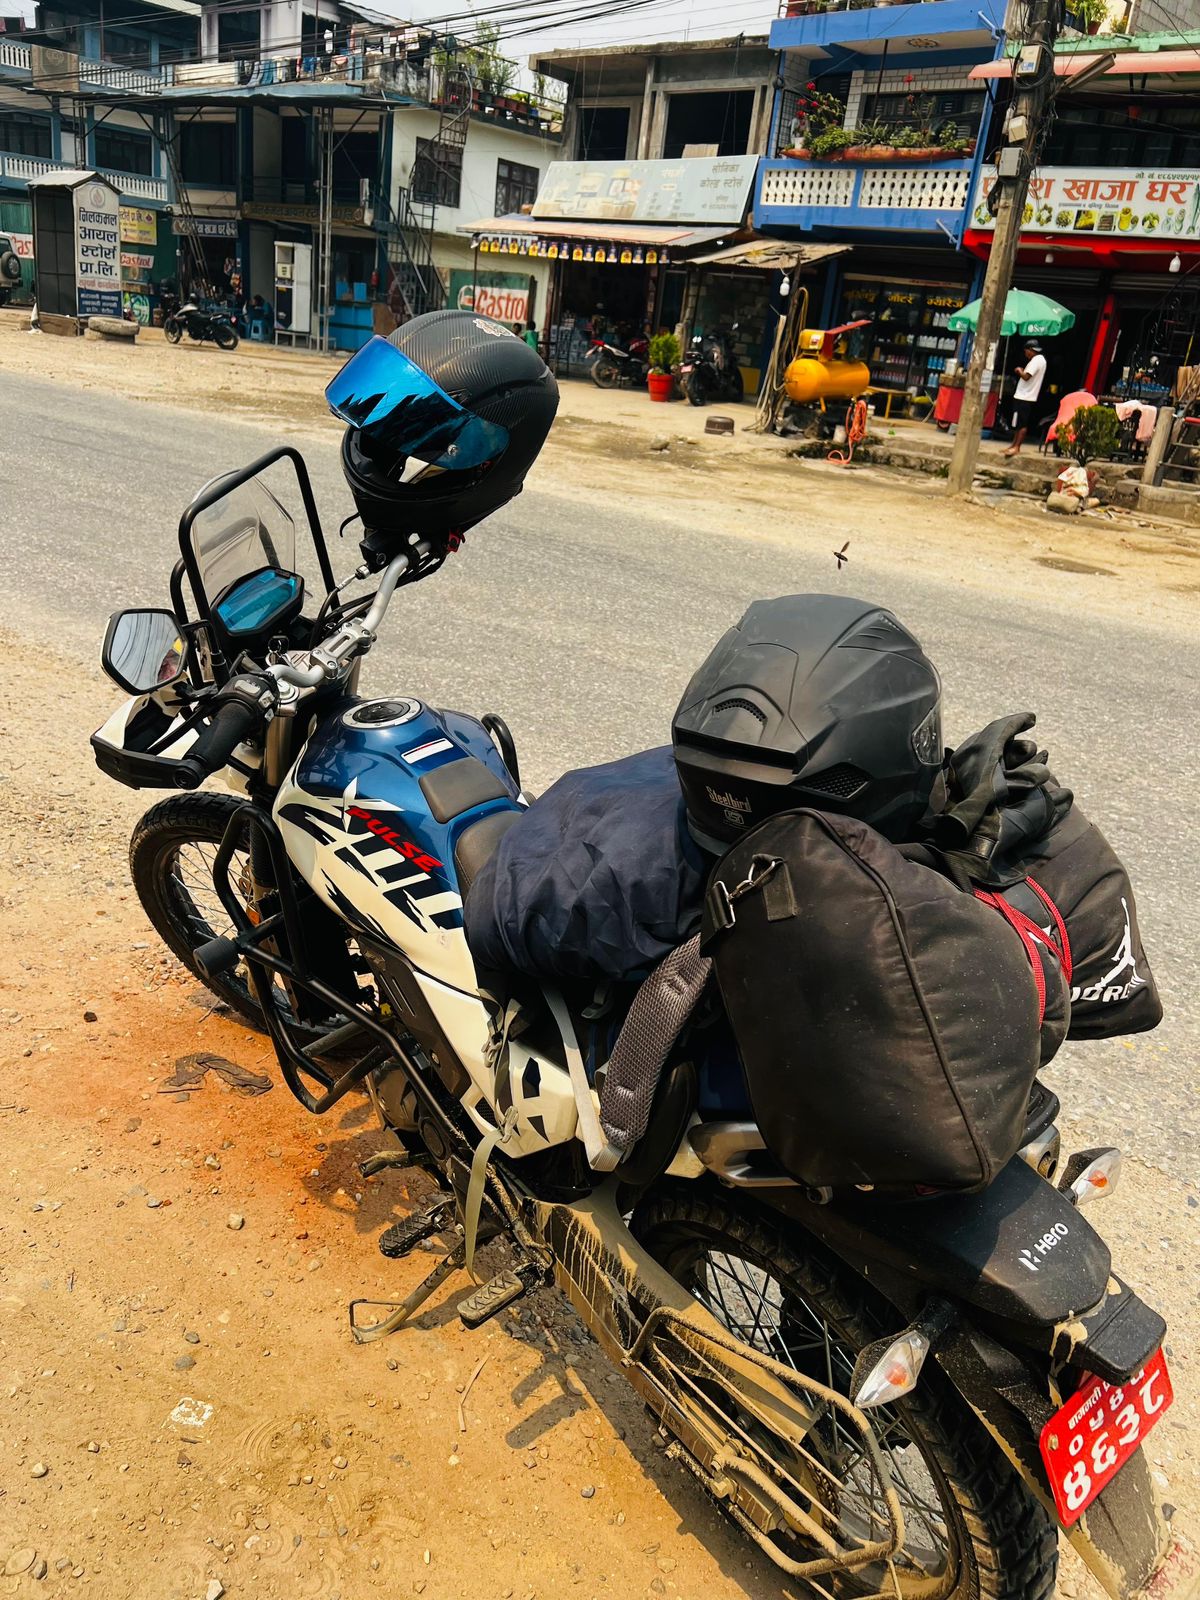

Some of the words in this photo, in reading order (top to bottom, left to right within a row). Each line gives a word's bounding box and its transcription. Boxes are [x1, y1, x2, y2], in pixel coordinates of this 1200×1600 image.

[1062, 179, 1139, 202] खाजा
[1145, 181, 1194, 205] घर
[79, 226, 118, 244] आयल
[81, 243, 117, 261] स्टोर्स
[120, 254, 151, 267] Castrol
[705, 785, 752, 812] Steelbird
[1034, 1222, 1069, 1255] Hero
